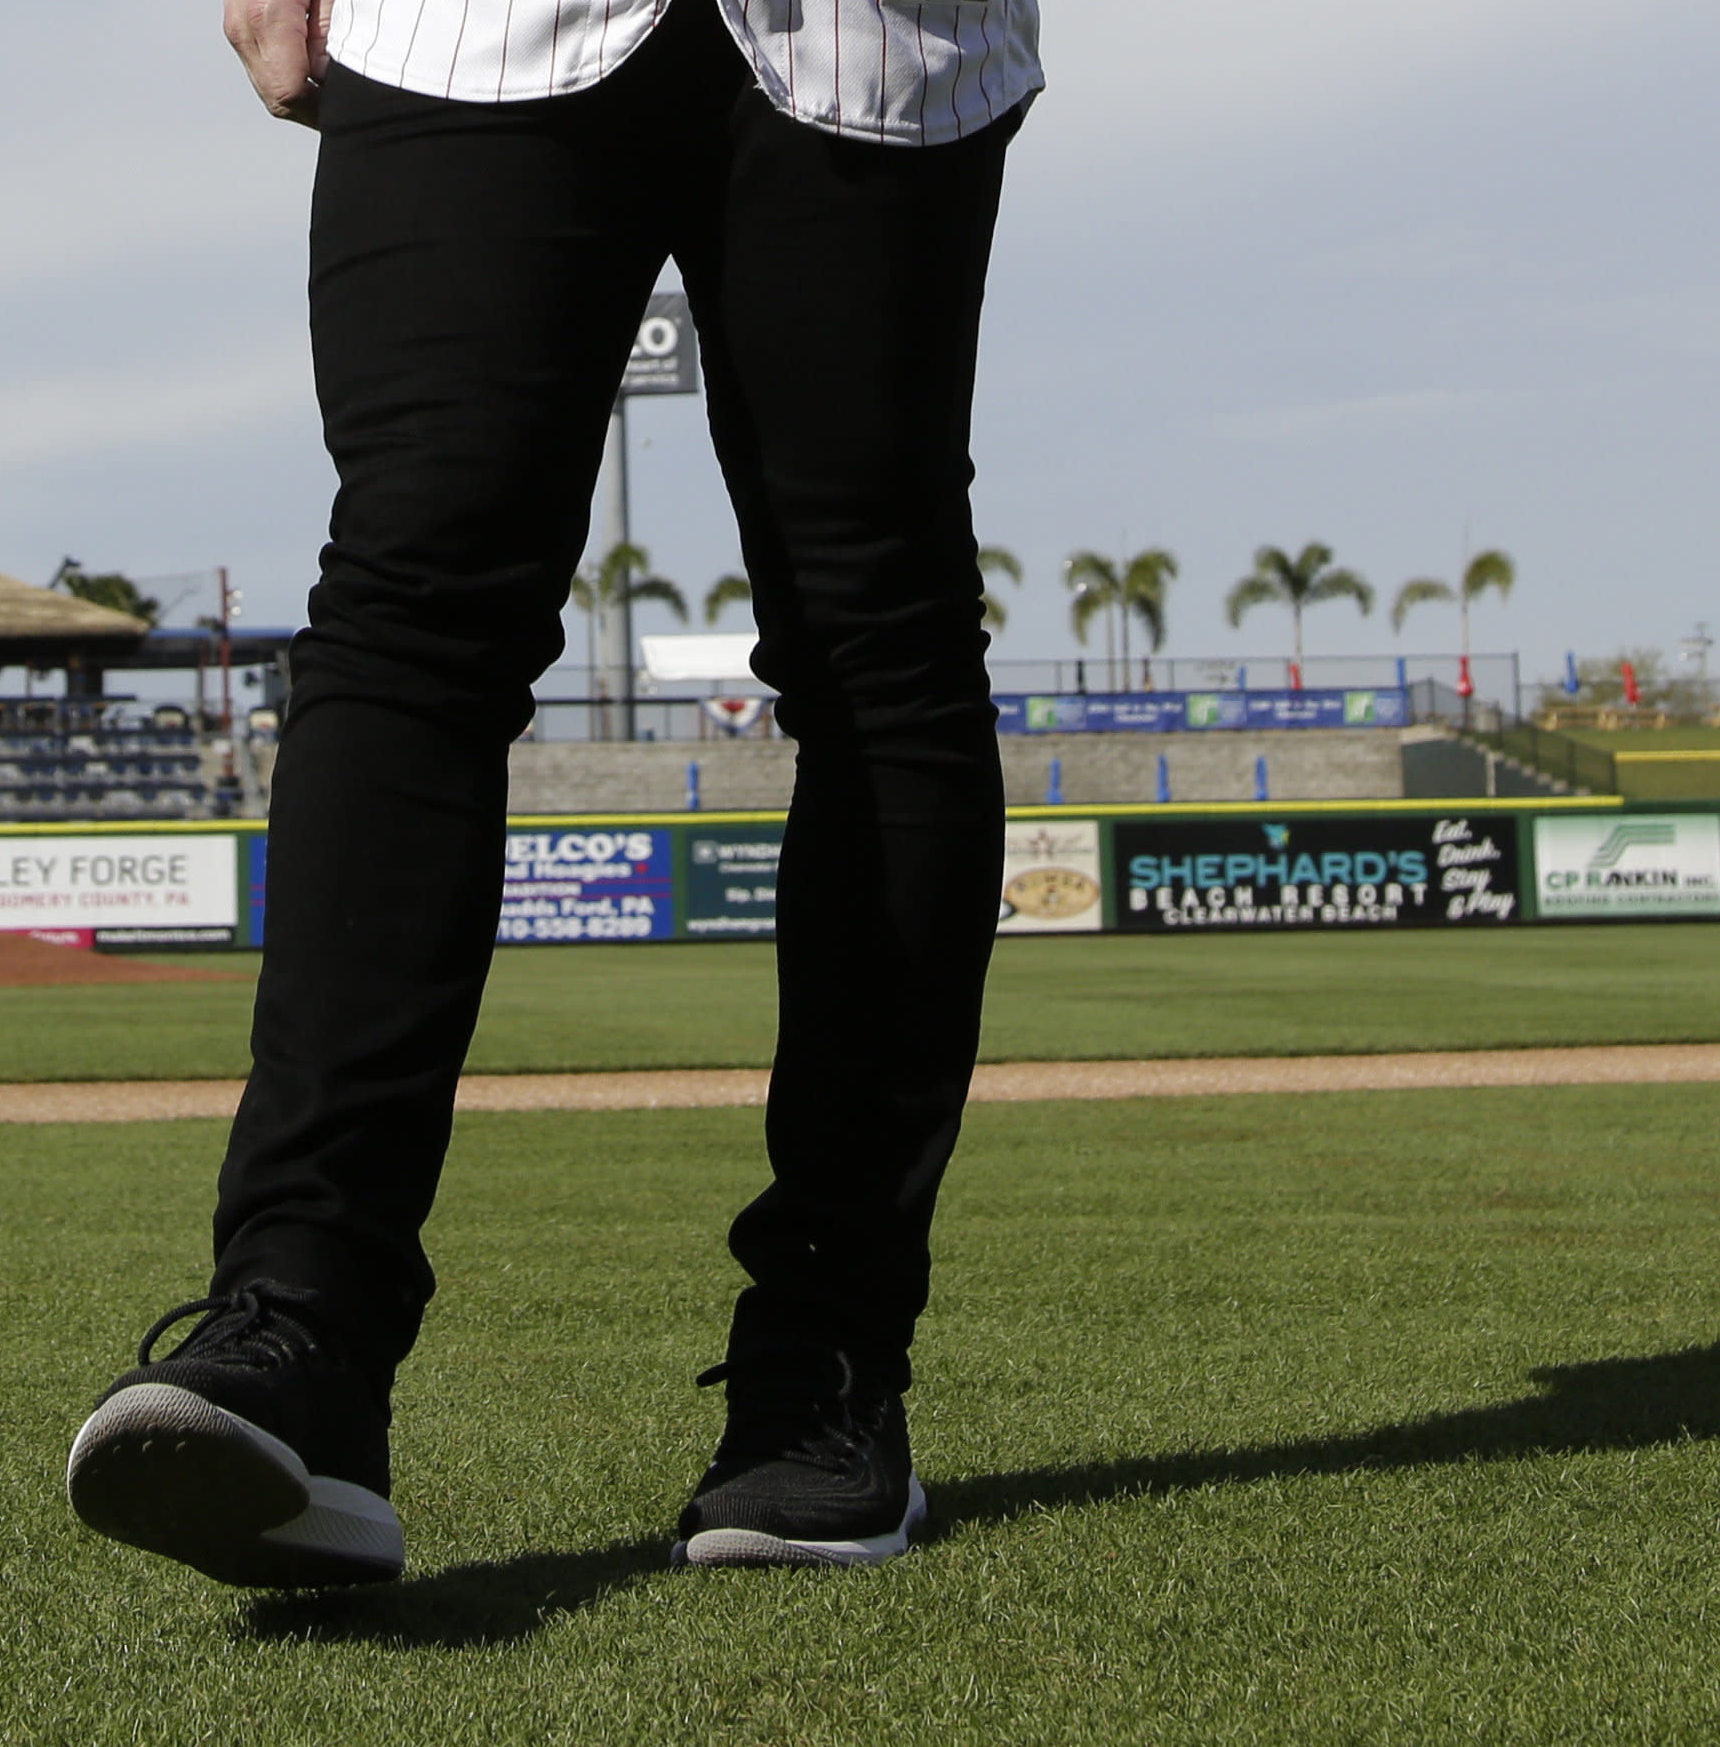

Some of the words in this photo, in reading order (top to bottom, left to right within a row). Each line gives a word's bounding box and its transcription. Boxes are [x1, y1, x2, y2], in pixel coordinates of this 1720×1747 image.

[1432, 818, 1473, 845] Eat.
[506, 833, 654, 863] ELCO'S
[70, 854, 188, 887] FORGE
[533, 861, 633, 882] Hoagies
[1129, 851, 1429, 890] SHEPHARD'S
[1441, 867, 1492, 894] Stay
[1546, 870, 1579, 890] CP
[1585, 868, 1679, 887] RANKIN
[164, 890, 190, 908] PA
[621, 895, 655, 916] PA
[1129, 886, 1254, 911] BEACH
[1281, 882, 1428, 907] RESORT
[1162, 904, 1314, 926] CLEARWATER
[1320, 903, 1398, 923] BEACH
